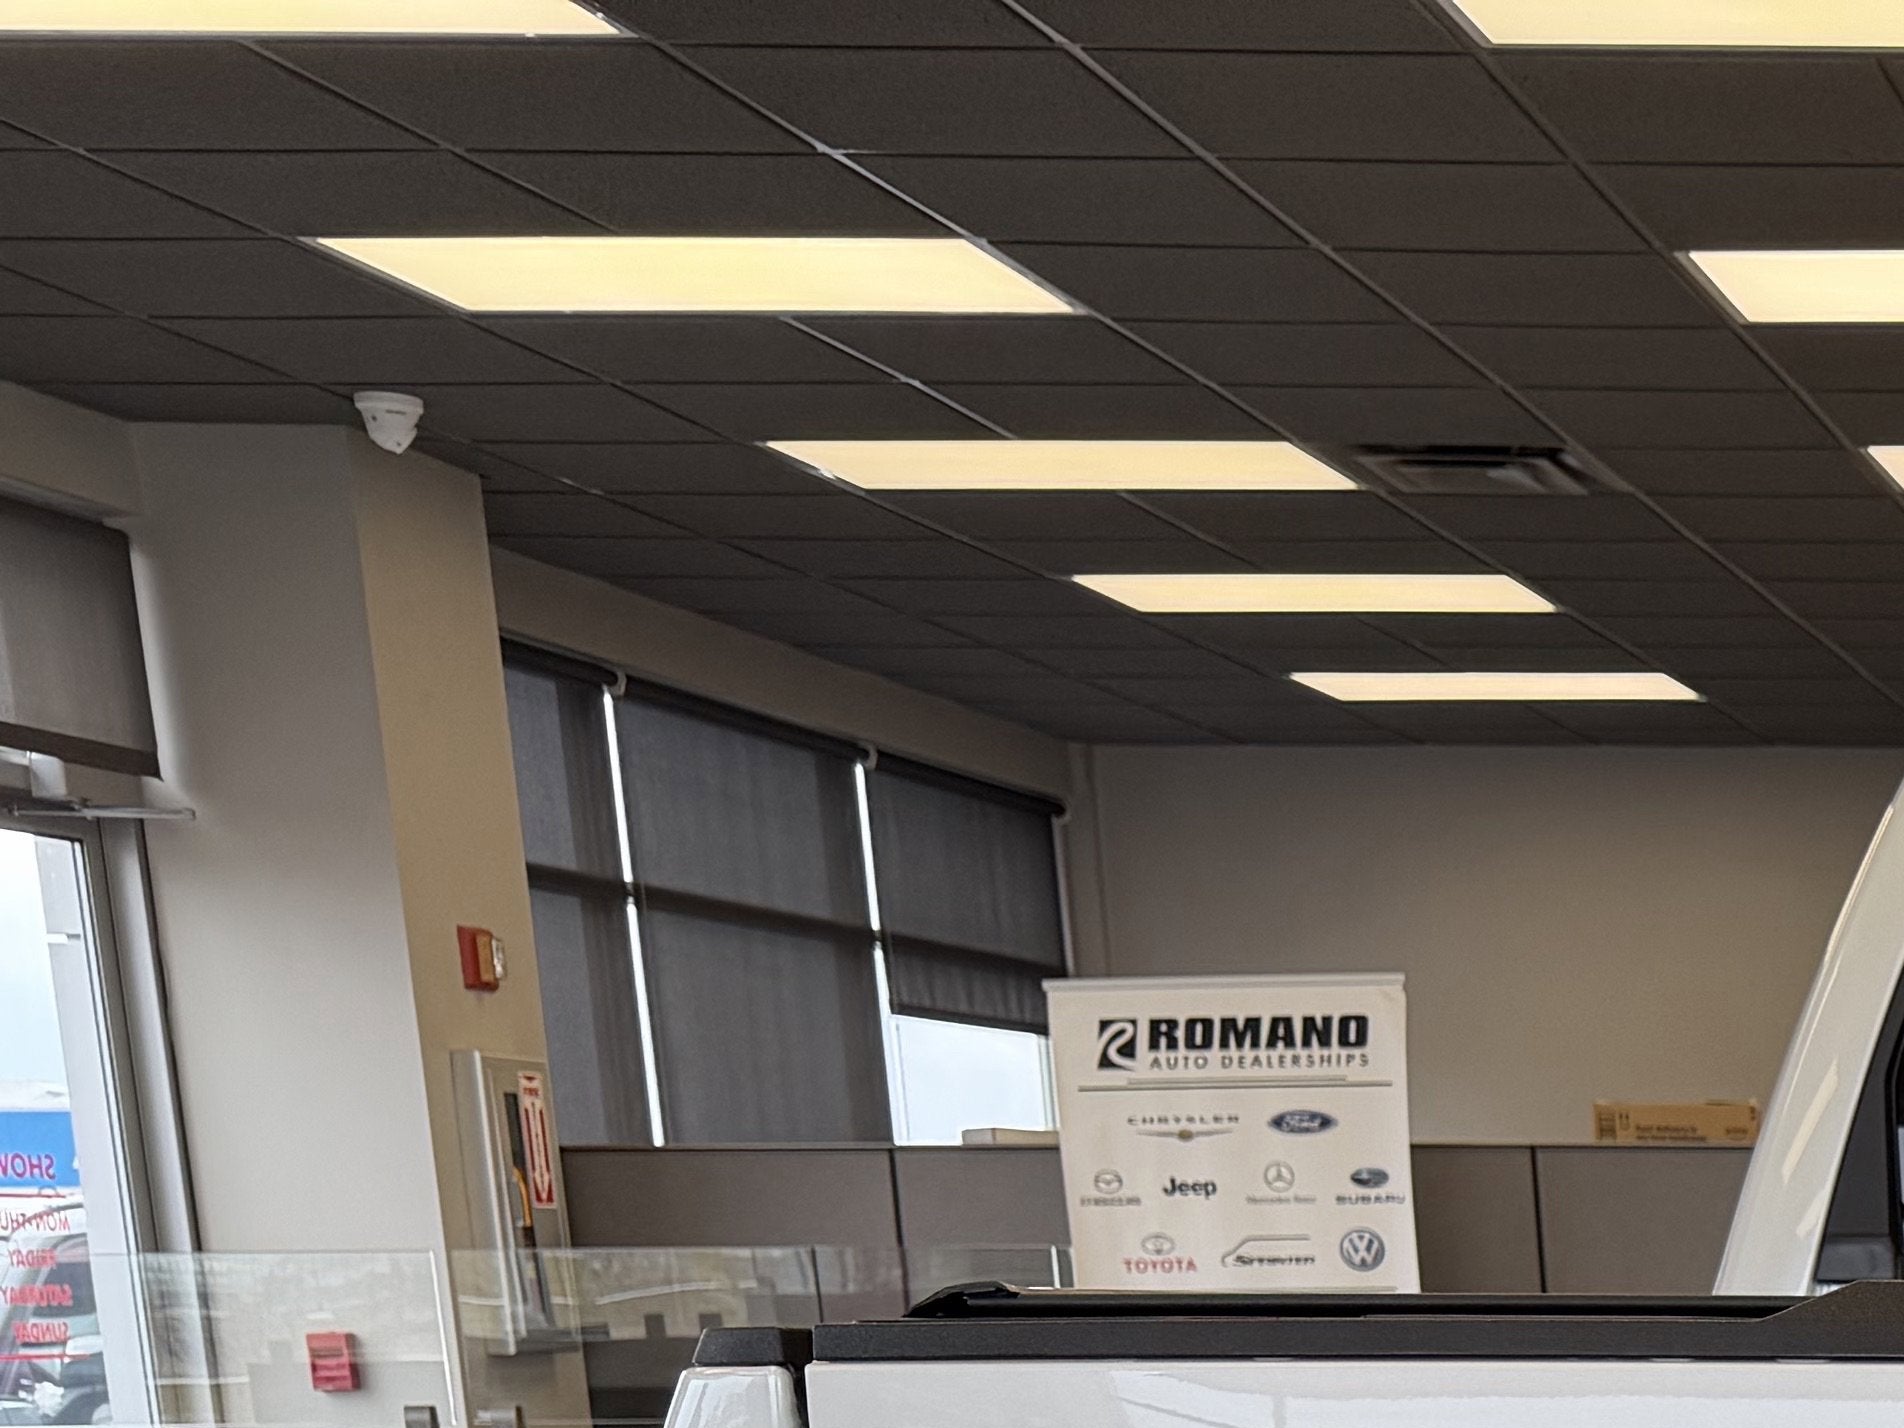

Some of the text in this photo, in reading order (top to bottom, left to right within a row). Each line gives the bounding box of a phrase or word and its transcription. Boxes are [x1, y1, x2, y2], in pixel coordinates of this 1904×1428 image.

[1148, 1014, 1369, 1051] ROMANO
[1149, 1052, 1370, 1071] AUTO DEALERSHIPS
[1162, 1175, 1217, 1201] Jeep
[1123, 1256, 1198, 1275] TOYOTA
